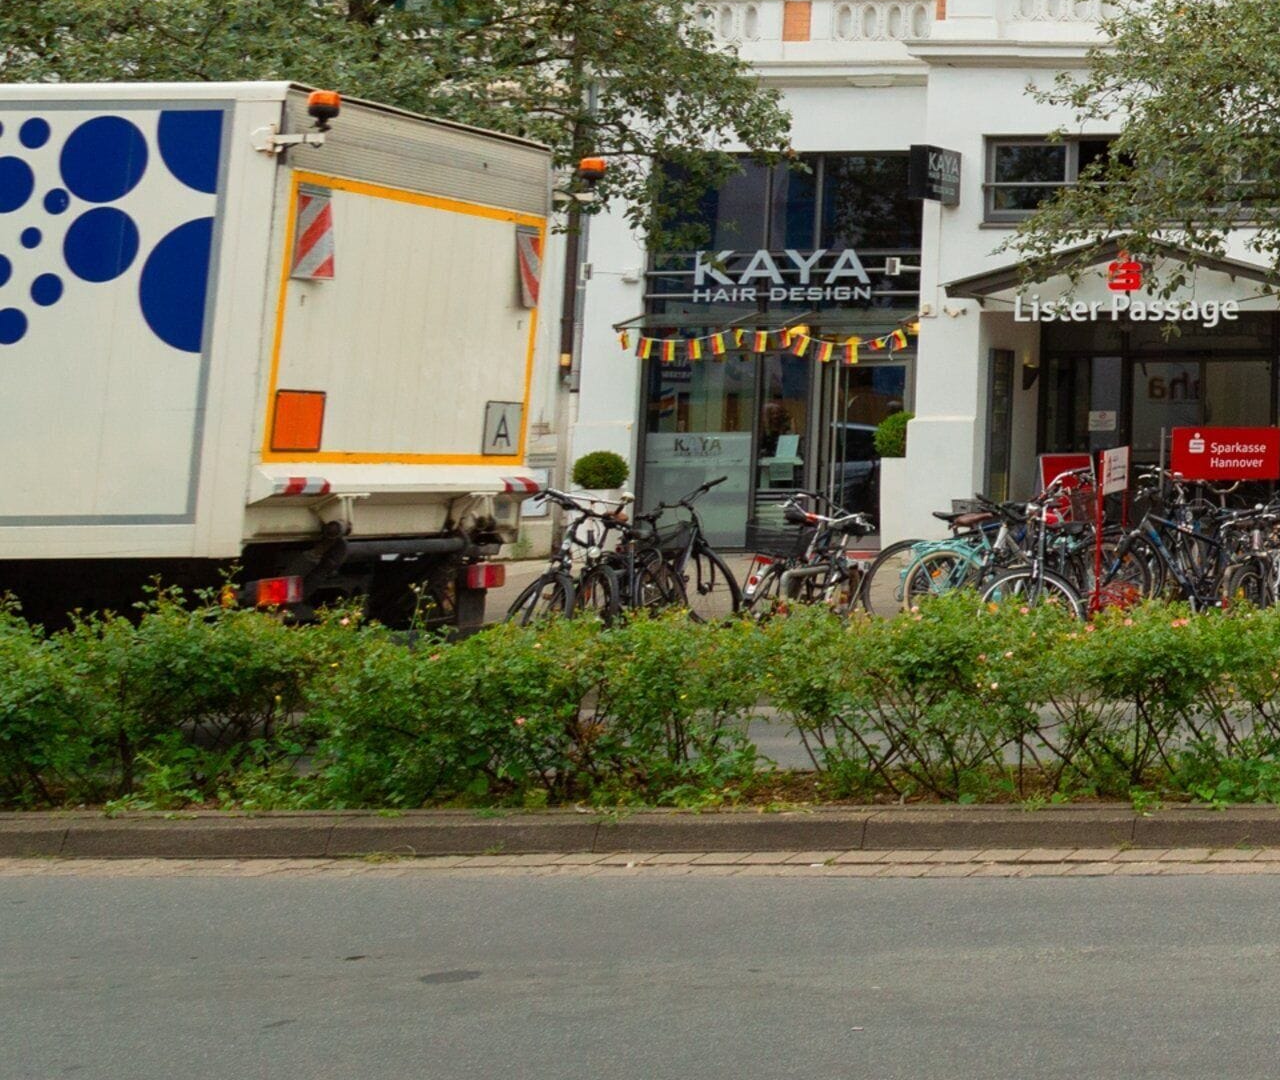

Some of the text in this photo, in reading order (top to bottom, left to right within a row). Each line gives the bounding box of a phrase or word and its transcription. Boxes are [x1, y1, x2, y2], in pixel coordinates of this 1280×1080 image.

[928, 151, 960, 177] KAYA
[693, 249, 871, 286] KAYA
[692, 285, 872, 303] HAIR DESIGN
[1110, 294, 1240, 328] Passage
[492, 411, 511, 447] A
[1210, 442, 1267, 455] Sparkasse
[1210, 457, 1264, 468] Hannover
